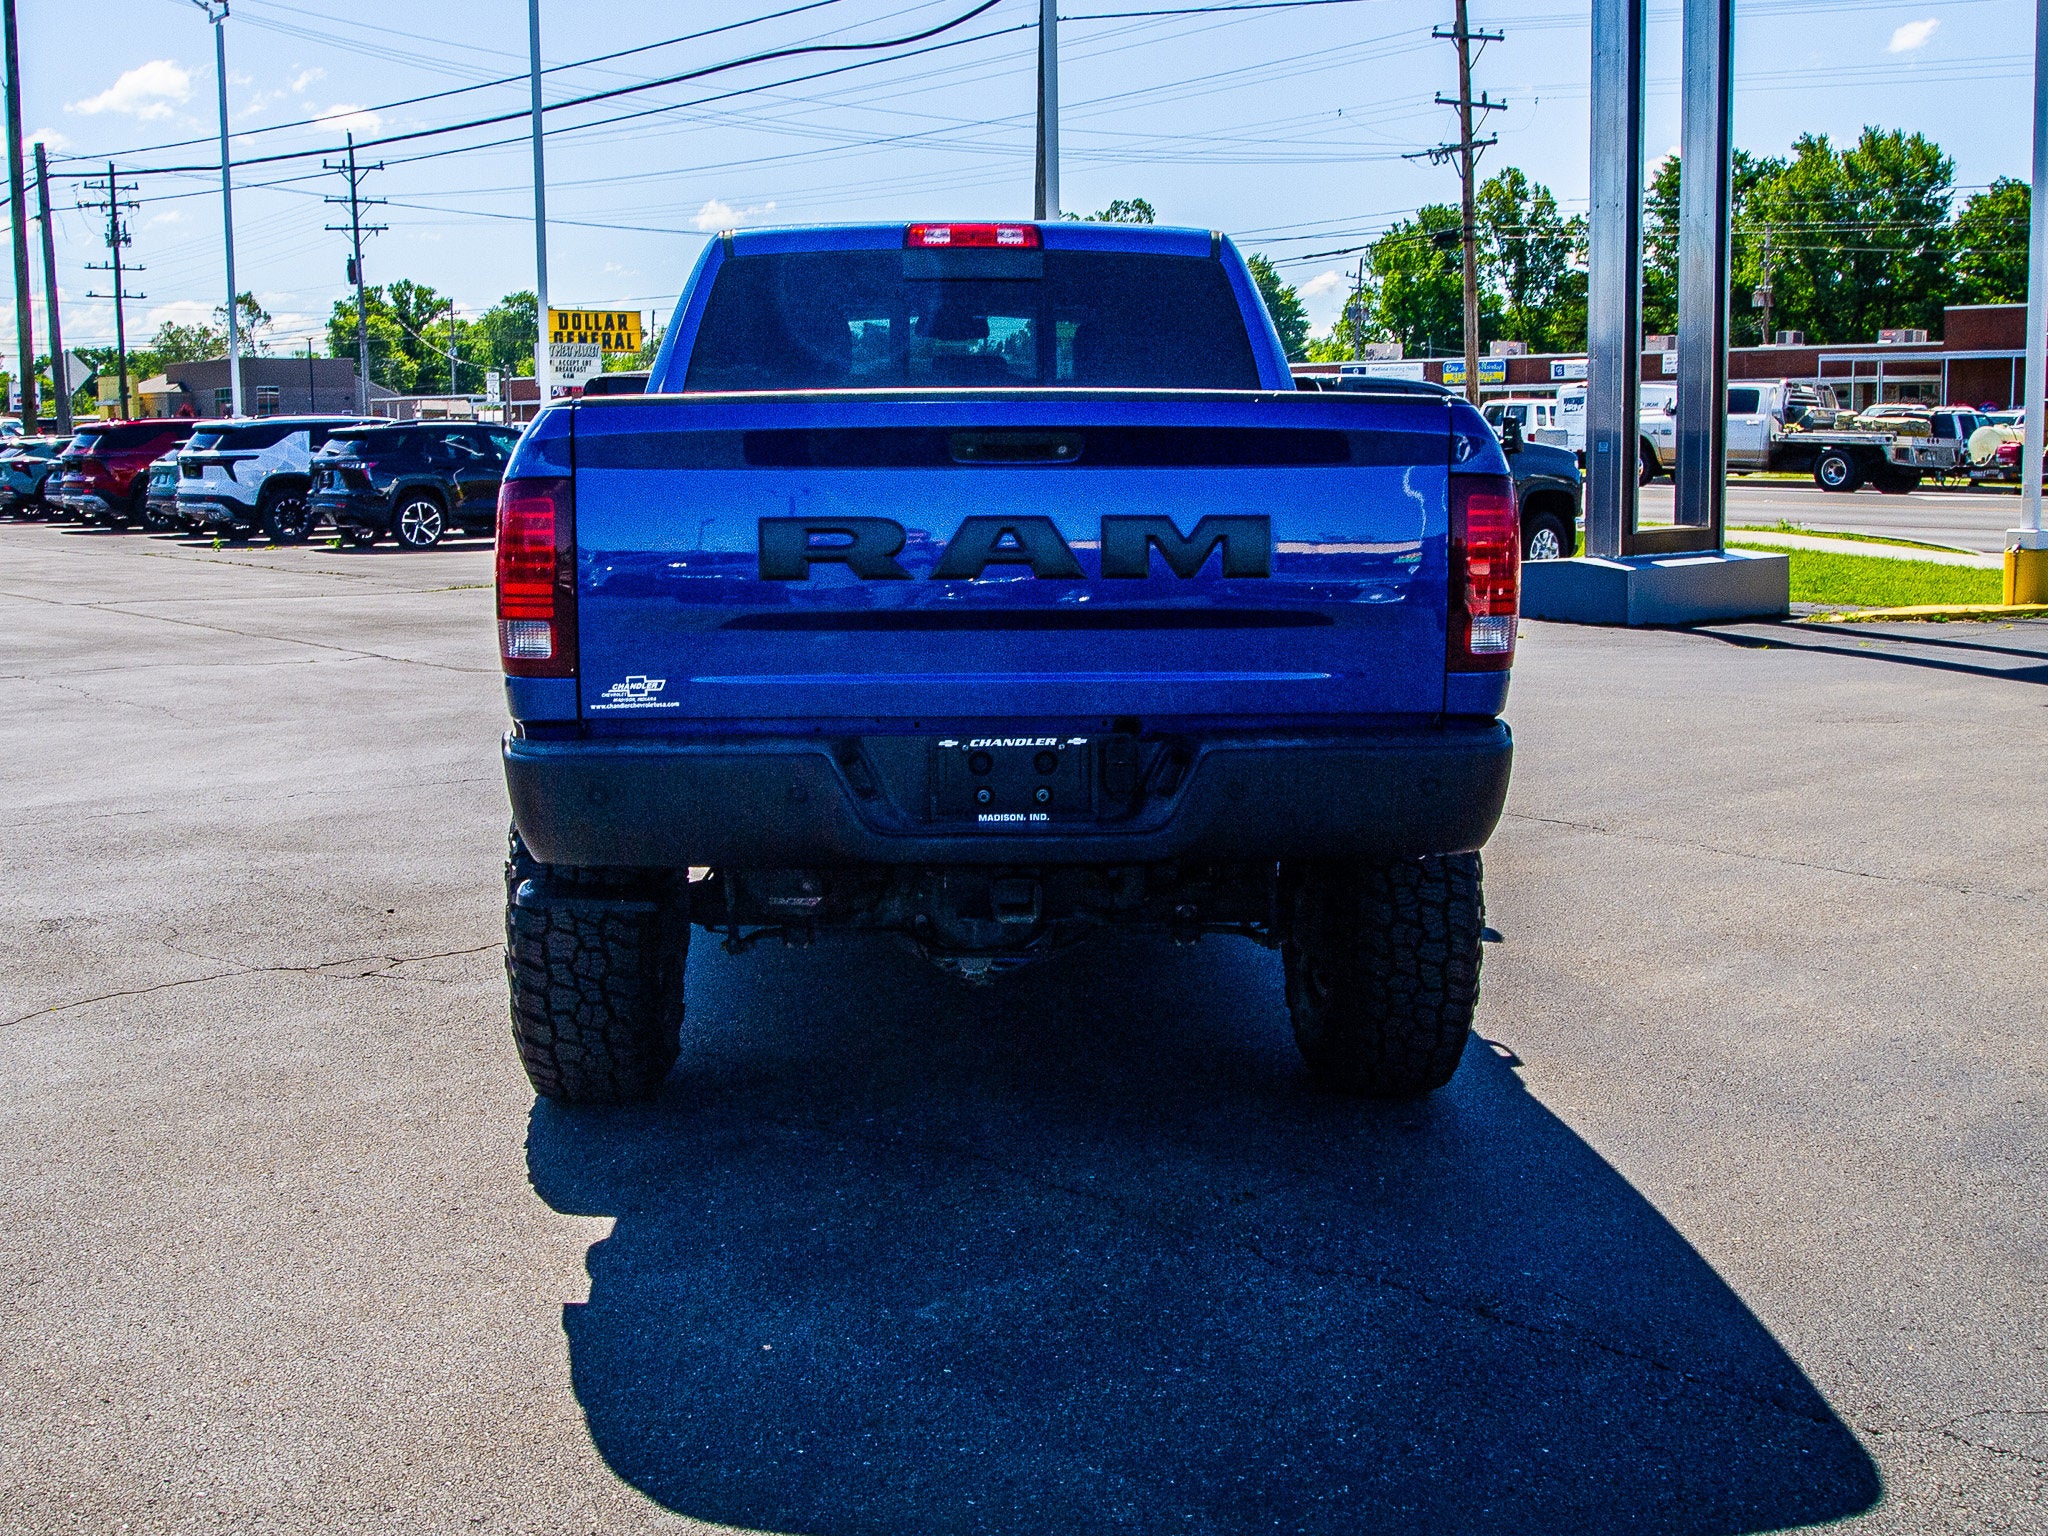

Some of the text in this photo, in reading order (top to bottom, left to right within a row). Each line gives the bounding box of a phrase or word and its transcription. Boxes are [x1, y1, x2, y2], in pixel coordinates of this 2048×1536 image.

[558, 312, 628, 330] DOLLAR
[554, 331, 635, 350] GENERAL
[757, 513, 1272, 582] RAM
[611, 681, 659, 691] CHANDLER
[969, 737, 1058, 748] CHANDLER
[1029, 813, 1050, 821] IND.
